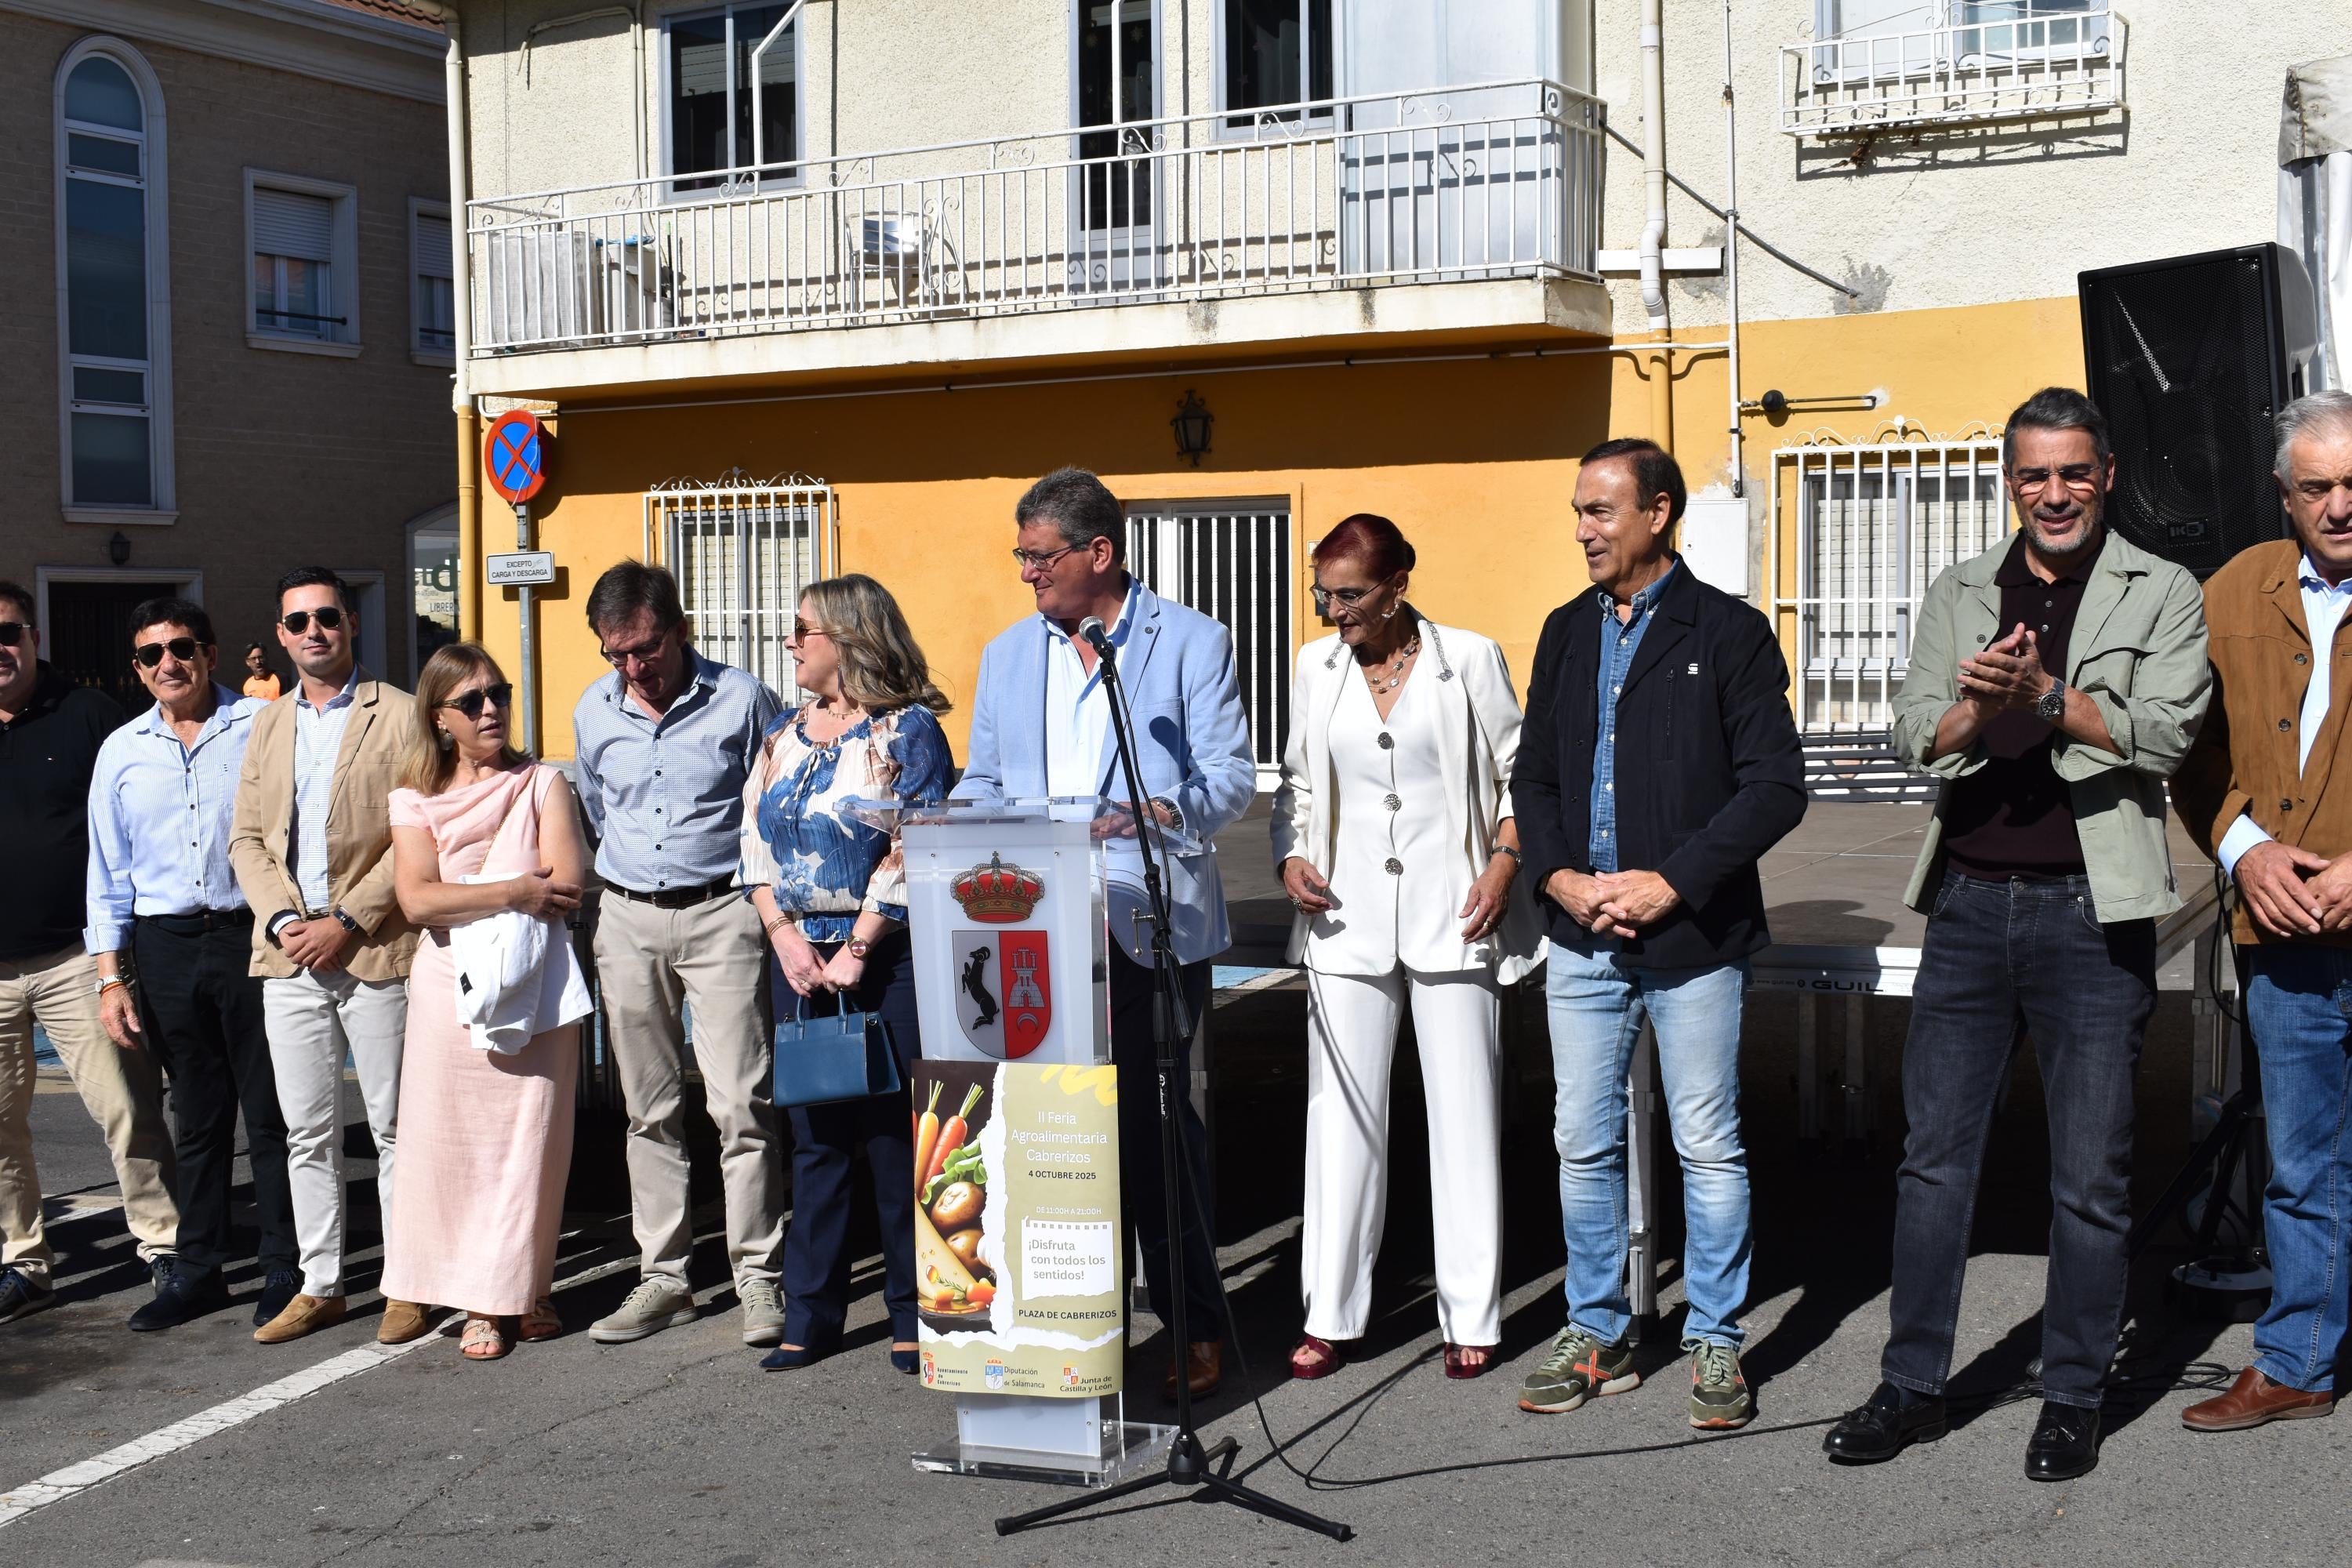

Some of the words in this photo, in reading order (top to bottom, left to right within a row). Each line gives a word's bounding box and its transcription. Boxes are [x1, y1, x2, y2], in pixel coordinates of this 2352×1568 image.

[430, 602, 460, 612] LIBRER
[1811, 980, 1884, 993] GUIL
[1048, 1112, 1077, 1125] Feria
[1011, 1128, 1108, 1145] Agroalimentaria
[1026, 1149, 1091, 1163] Cabrerizos
[1035, 1170, 1073, 1180] OCTUBRE
[1029, 1239, 1076, 1251] ¡Disfruta
[1031, 1256, 1051, 1265] con
[1053, 1255, 1086, 1265] todos
[1088, 1255, 1105, 1265] los
[1033, 1269, 1084, 1280] sentidos!
[1018, 1309, 1045, 1318] PLAZA
[1060, 1310, 1117, 1319] CABRERIZOS
[1004, 1366, 1038, 1375] Diputación
[1011, 1380, 1045, 1388] Salamanca
